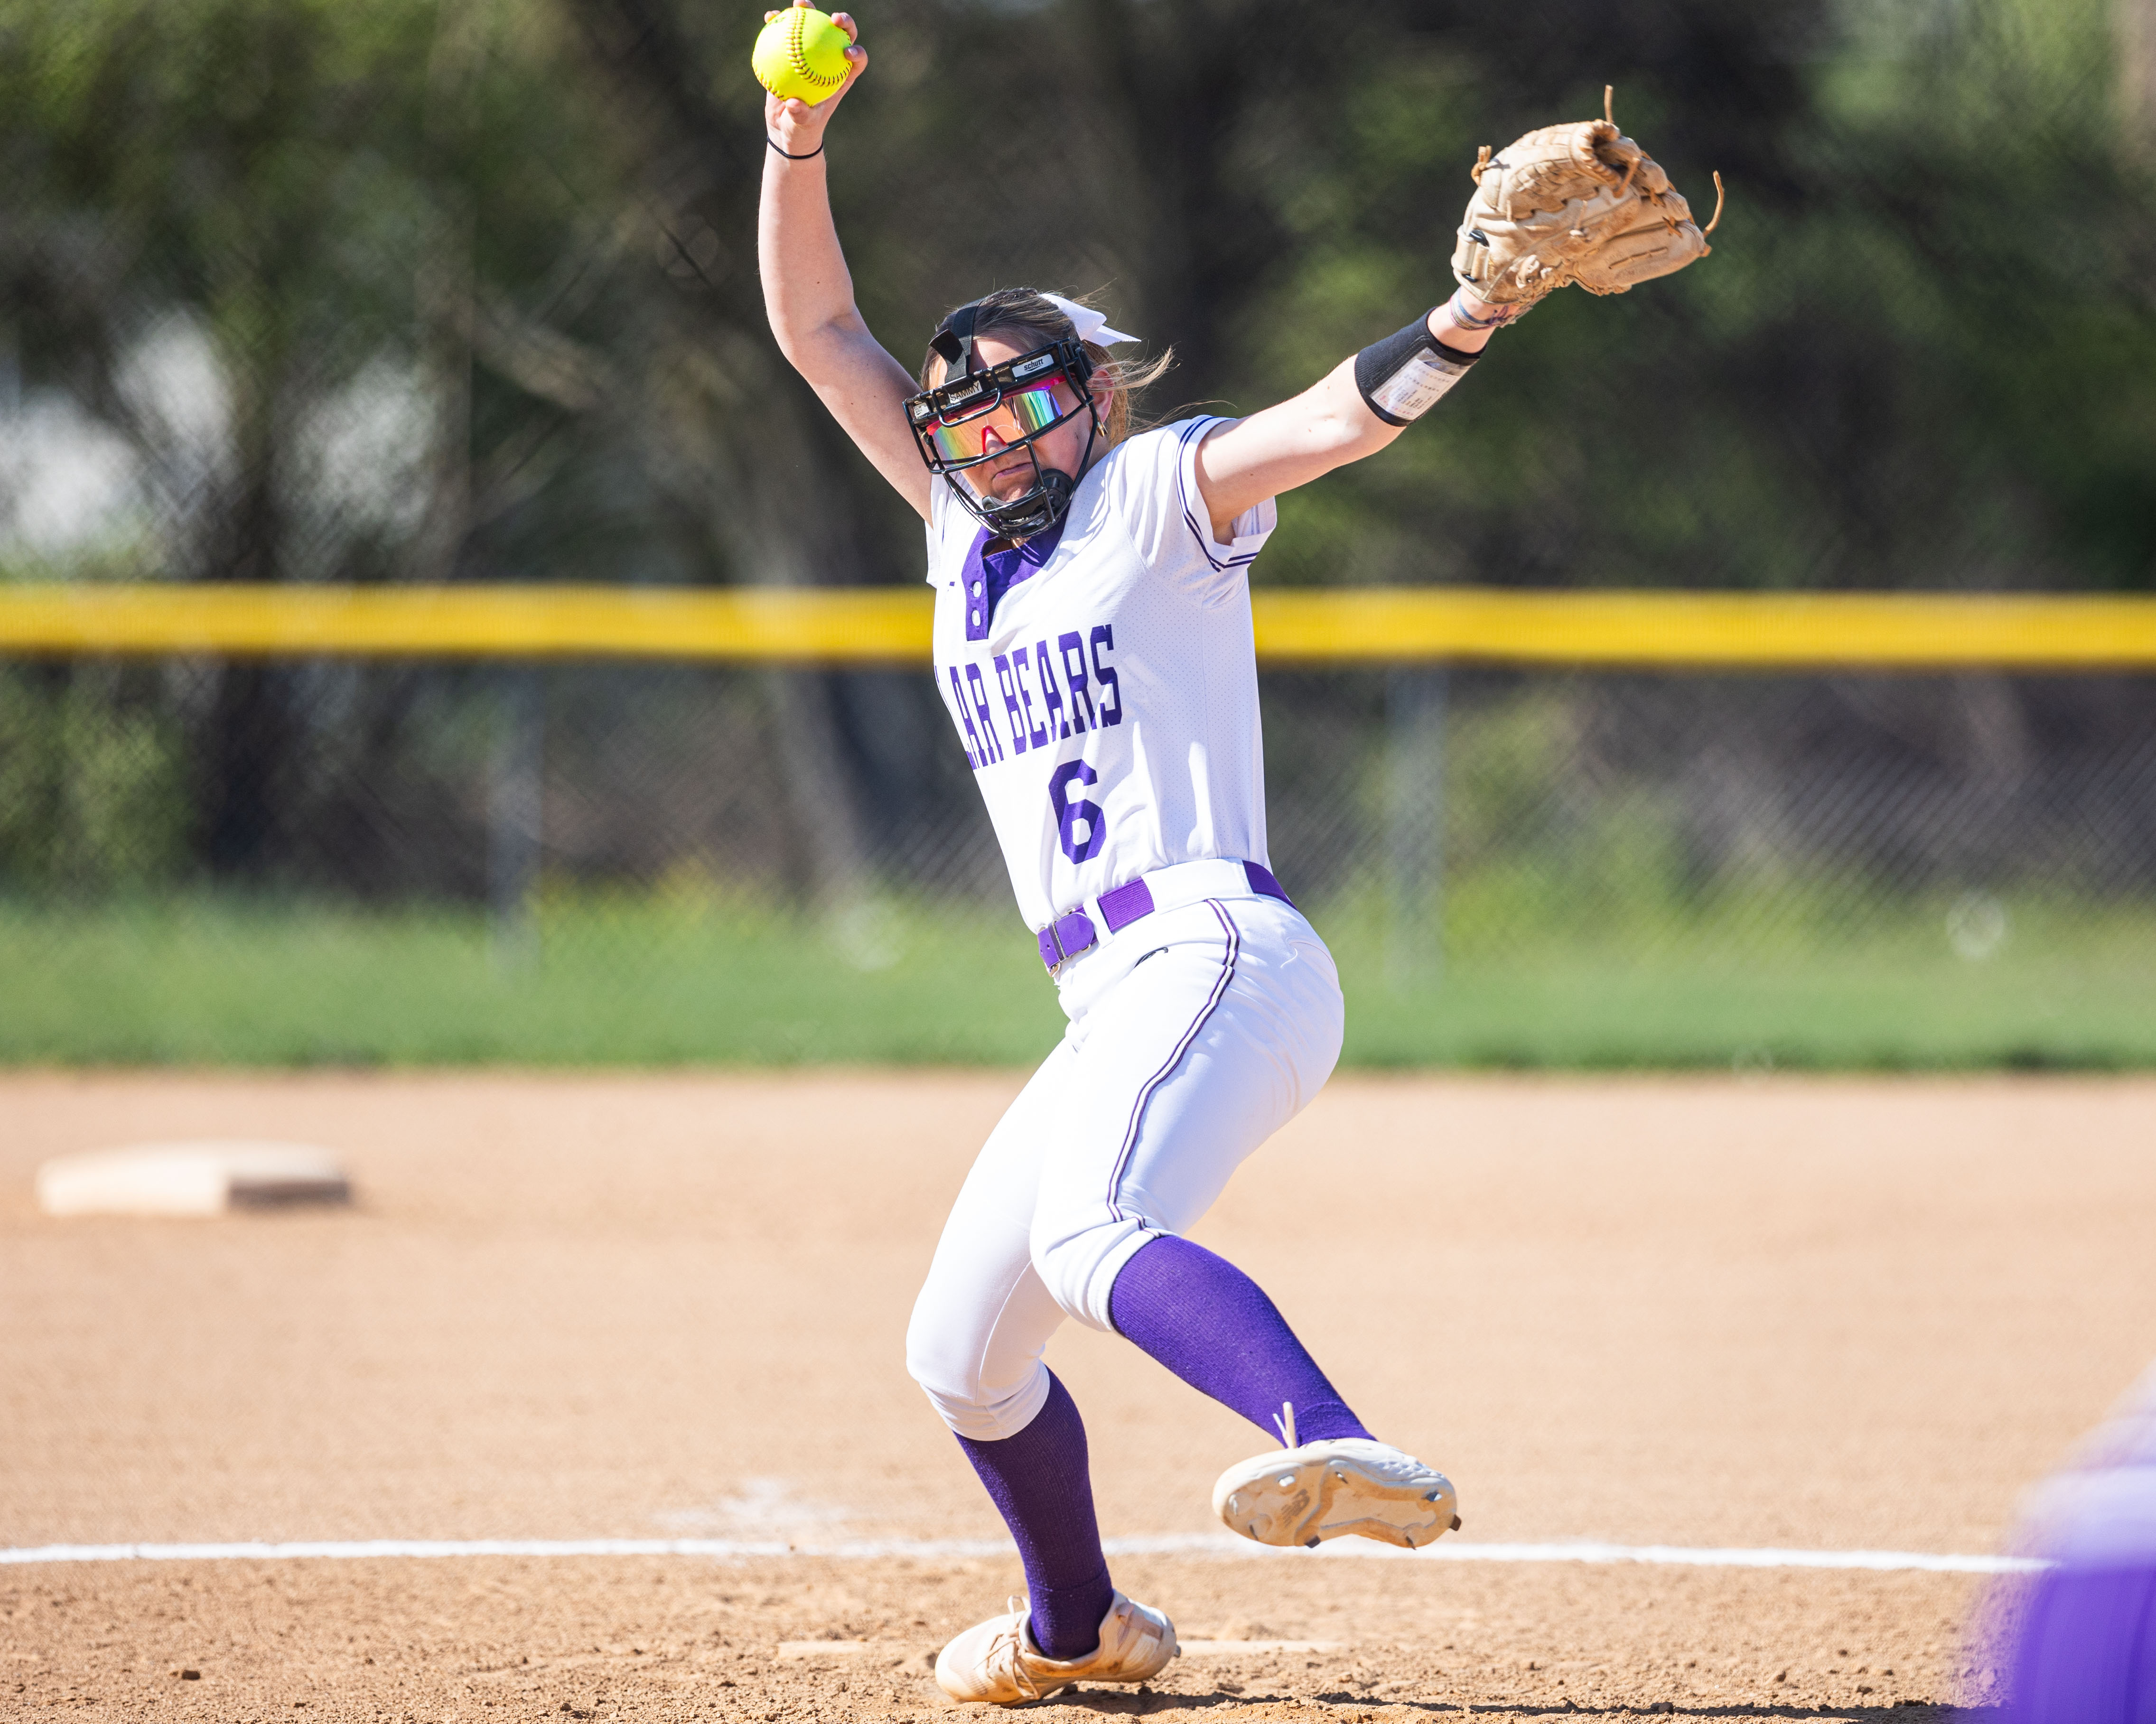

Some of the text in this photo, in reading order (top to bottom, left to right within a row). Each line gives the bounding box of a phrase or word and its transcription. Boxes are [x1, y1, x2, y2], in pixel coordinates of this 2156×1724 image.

[950, 382, 980, 401] SAMMY
[1024, 358, 1044, 371] schutt
[935, 624, 1122, 770] AR BEARS
[1048, 758, 1106, 865] 6
